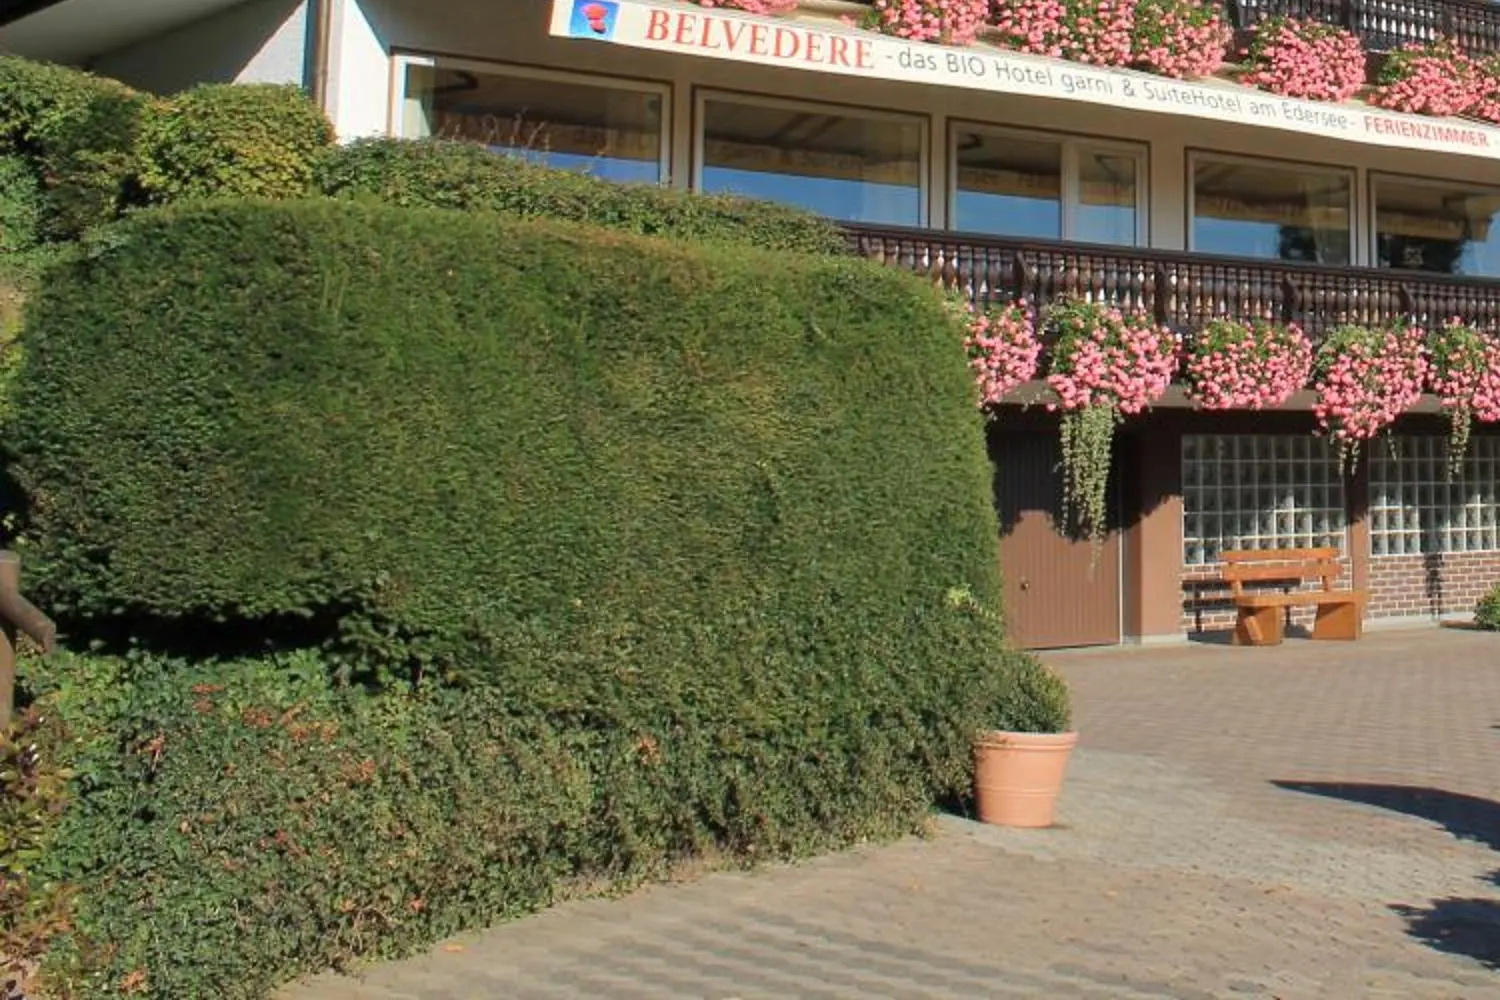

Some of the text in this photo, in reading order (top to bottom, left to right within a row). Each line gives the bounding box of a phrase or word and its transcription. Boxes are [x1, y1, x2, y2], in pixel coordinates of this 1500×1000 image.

[645, 9, 875, 69] BELVEDERE
[898, 48, 937, 71] das
[945, 52, 986, 77] BIO
[995, 59, 1053, 87] Hotel
[1061, 72, 1113, 94] garni
[1123, 78, 1136, 97] &
[1144, 80, 1241, 113] SuiteHotel
[1249, 101, 1277, 118] am
[1363, 115, 1490, 147] FERIENZIMMER
